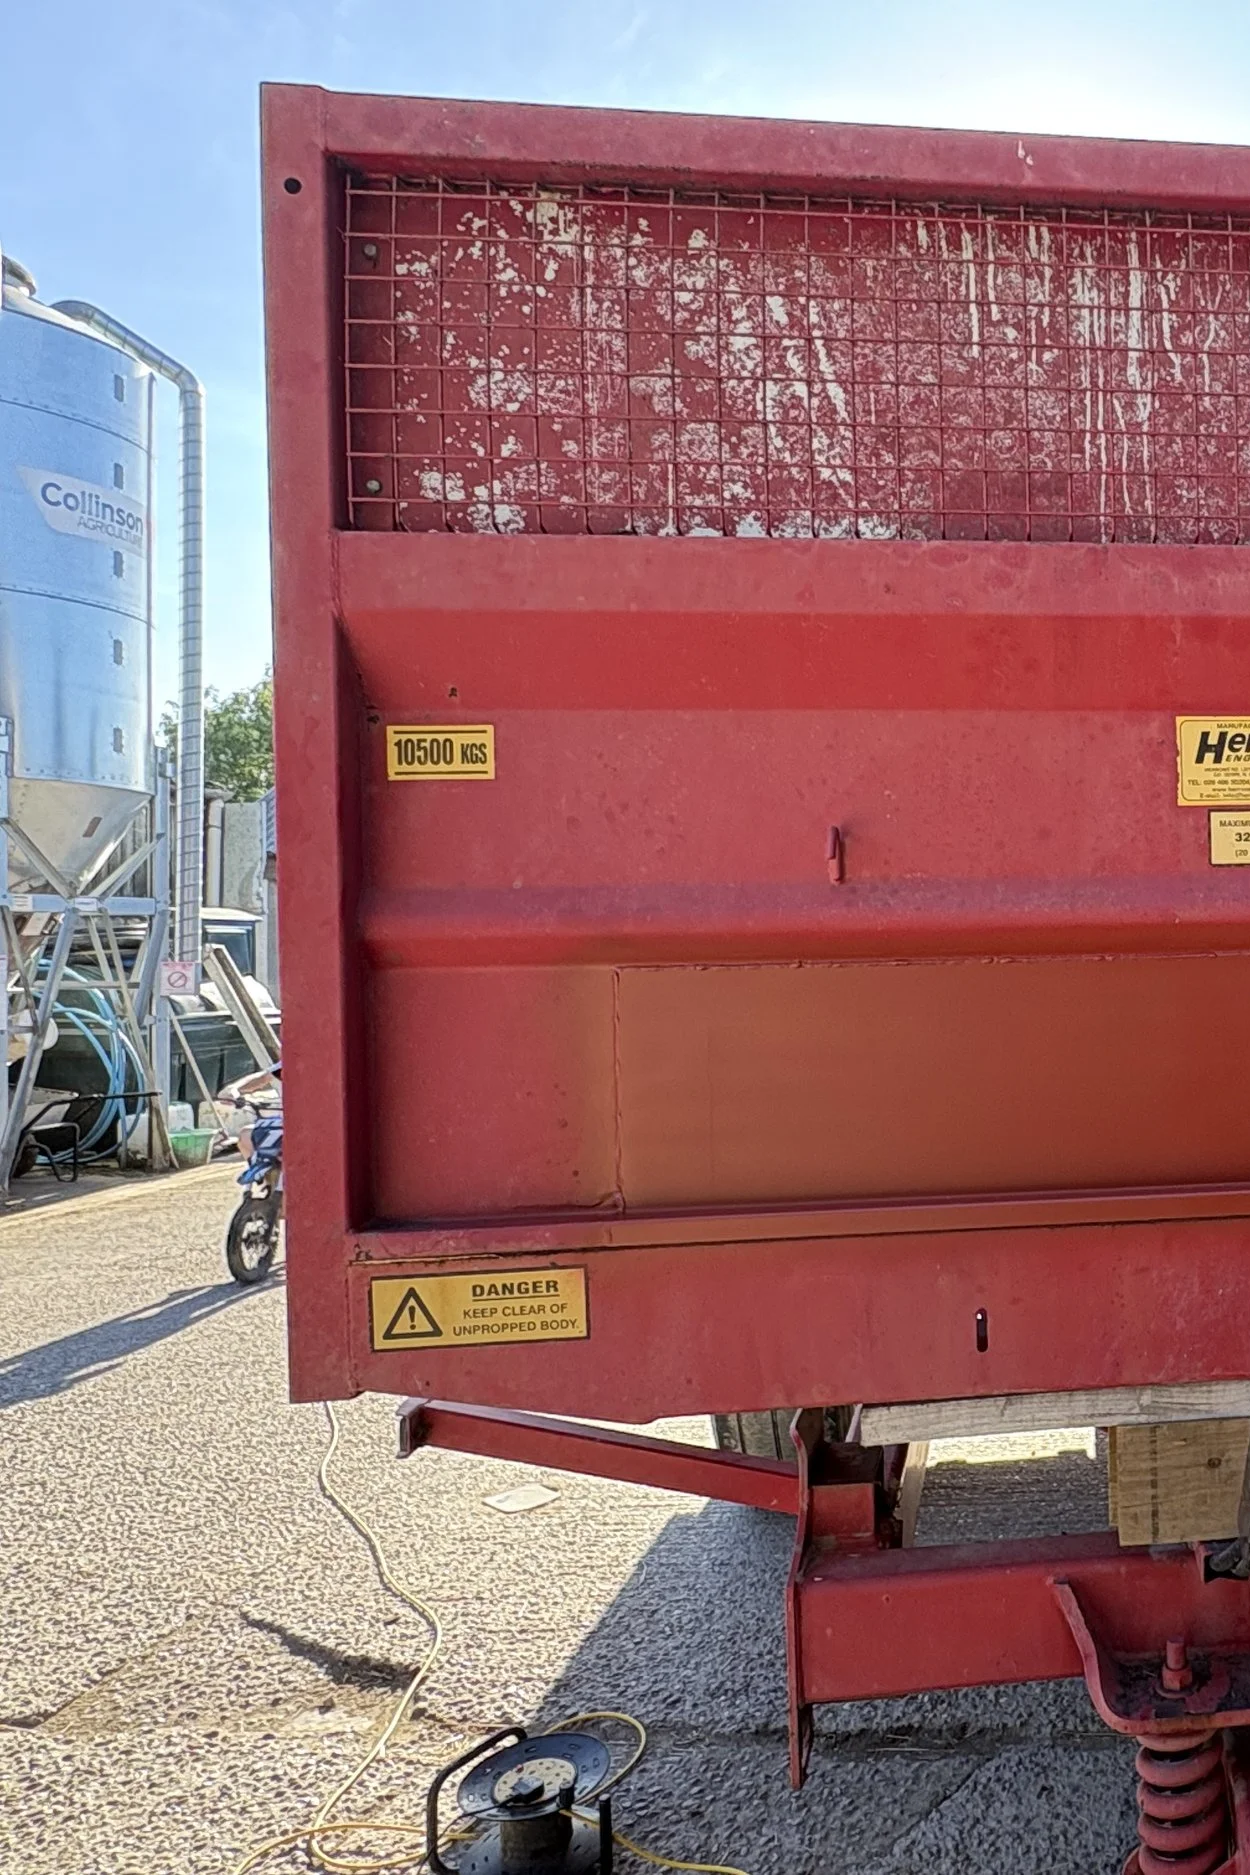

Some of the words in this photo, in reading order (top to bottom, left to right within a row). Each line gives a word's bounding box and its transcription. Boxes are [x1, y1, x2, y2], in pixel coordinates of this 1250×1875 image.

[40, 482, 144, 536] Collinson
[393, 737, 454, 766] 10500
[460, 742, 488, 765] KGS
[1234, 832, 1250, 842] 32
[471, 1279, 560, 1298] DANGER
[463, 1307, 498, 1319] KEEP
[502, 1304, 546, 1317] CLEAR
[550, 1303, 568, 1315] OF
[453, 1322, 537, 1337] UNPROPPED
[541, 1318, 580, 1331] BODY.
